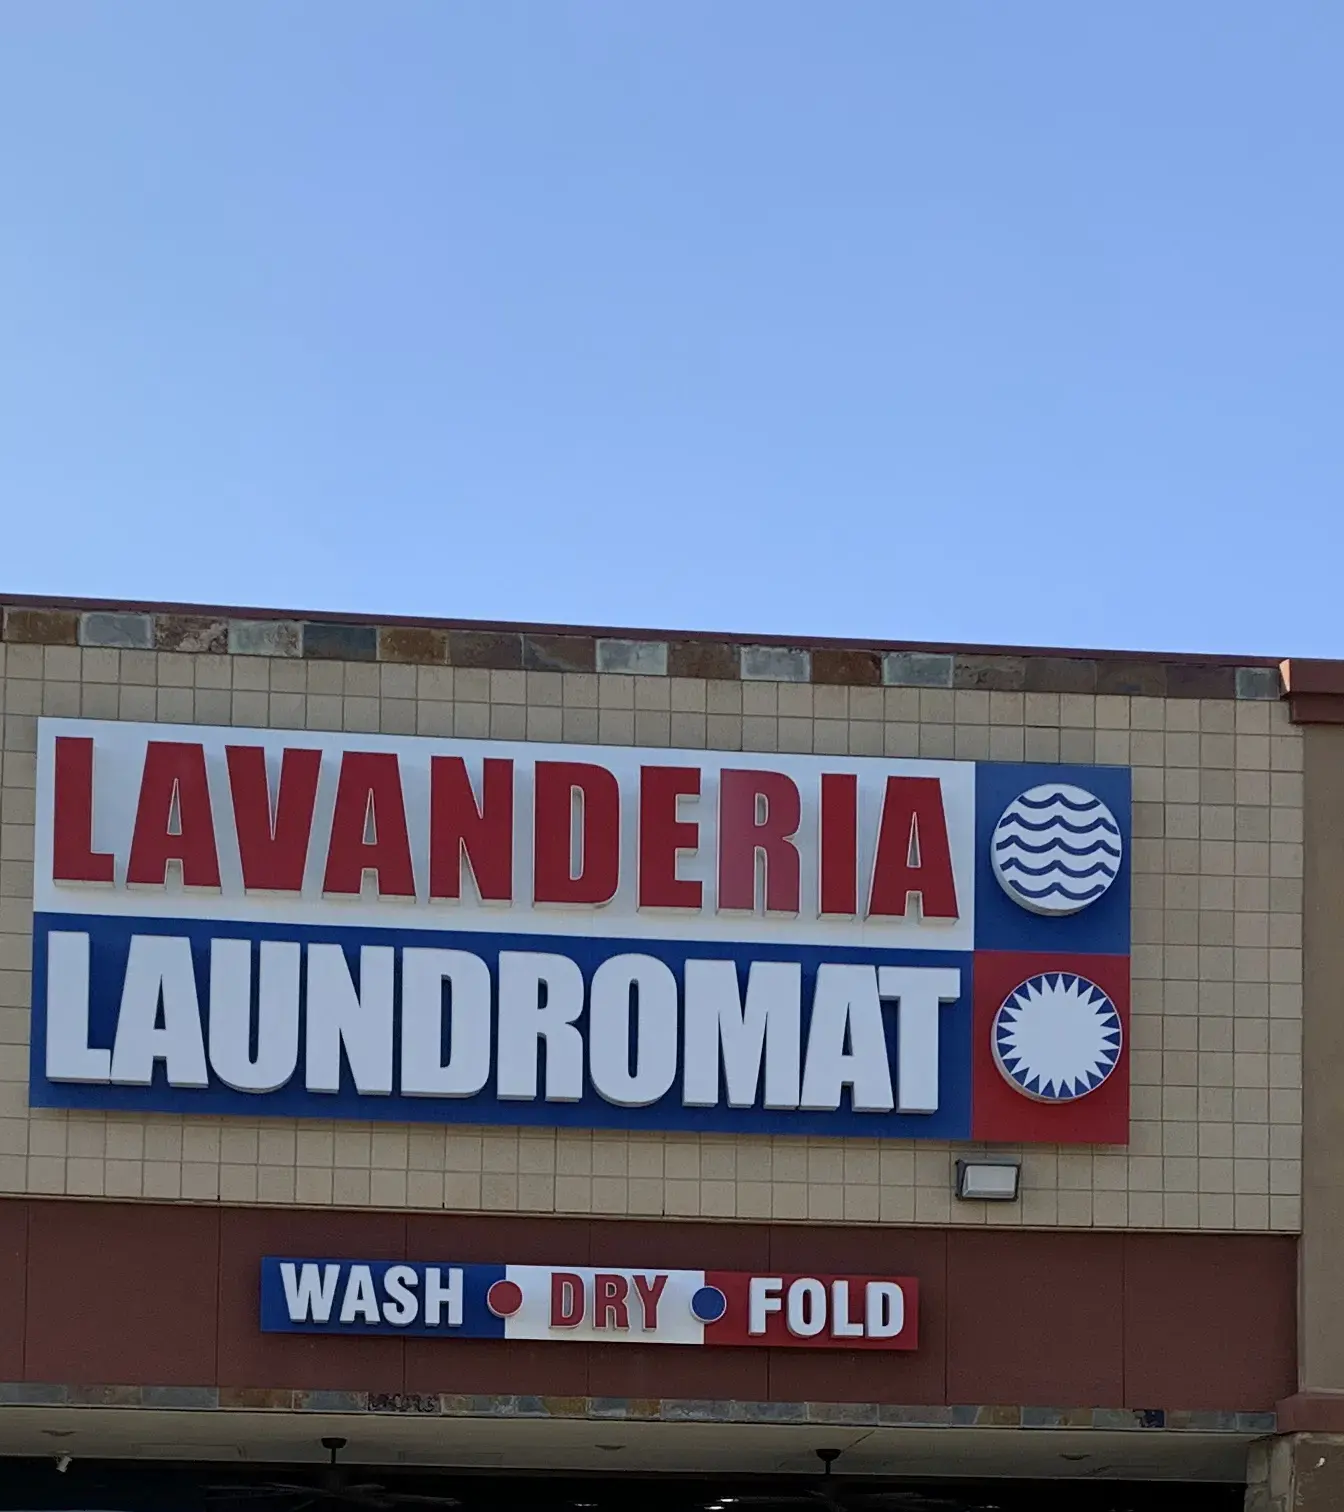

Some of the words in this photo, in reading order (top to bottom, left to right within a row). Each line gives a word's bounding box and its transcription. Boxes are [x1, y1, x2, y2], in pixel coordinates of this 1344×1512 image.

[53, 736, 959, 922] LAVANDERIA
[46, 931, 960, 1113] LAUNDROMAT
[280, 1262, 463, 1327] WASH
[549, 1272, 668, 1331] DRY
[749, 1277, 904, 1338] FOLD
